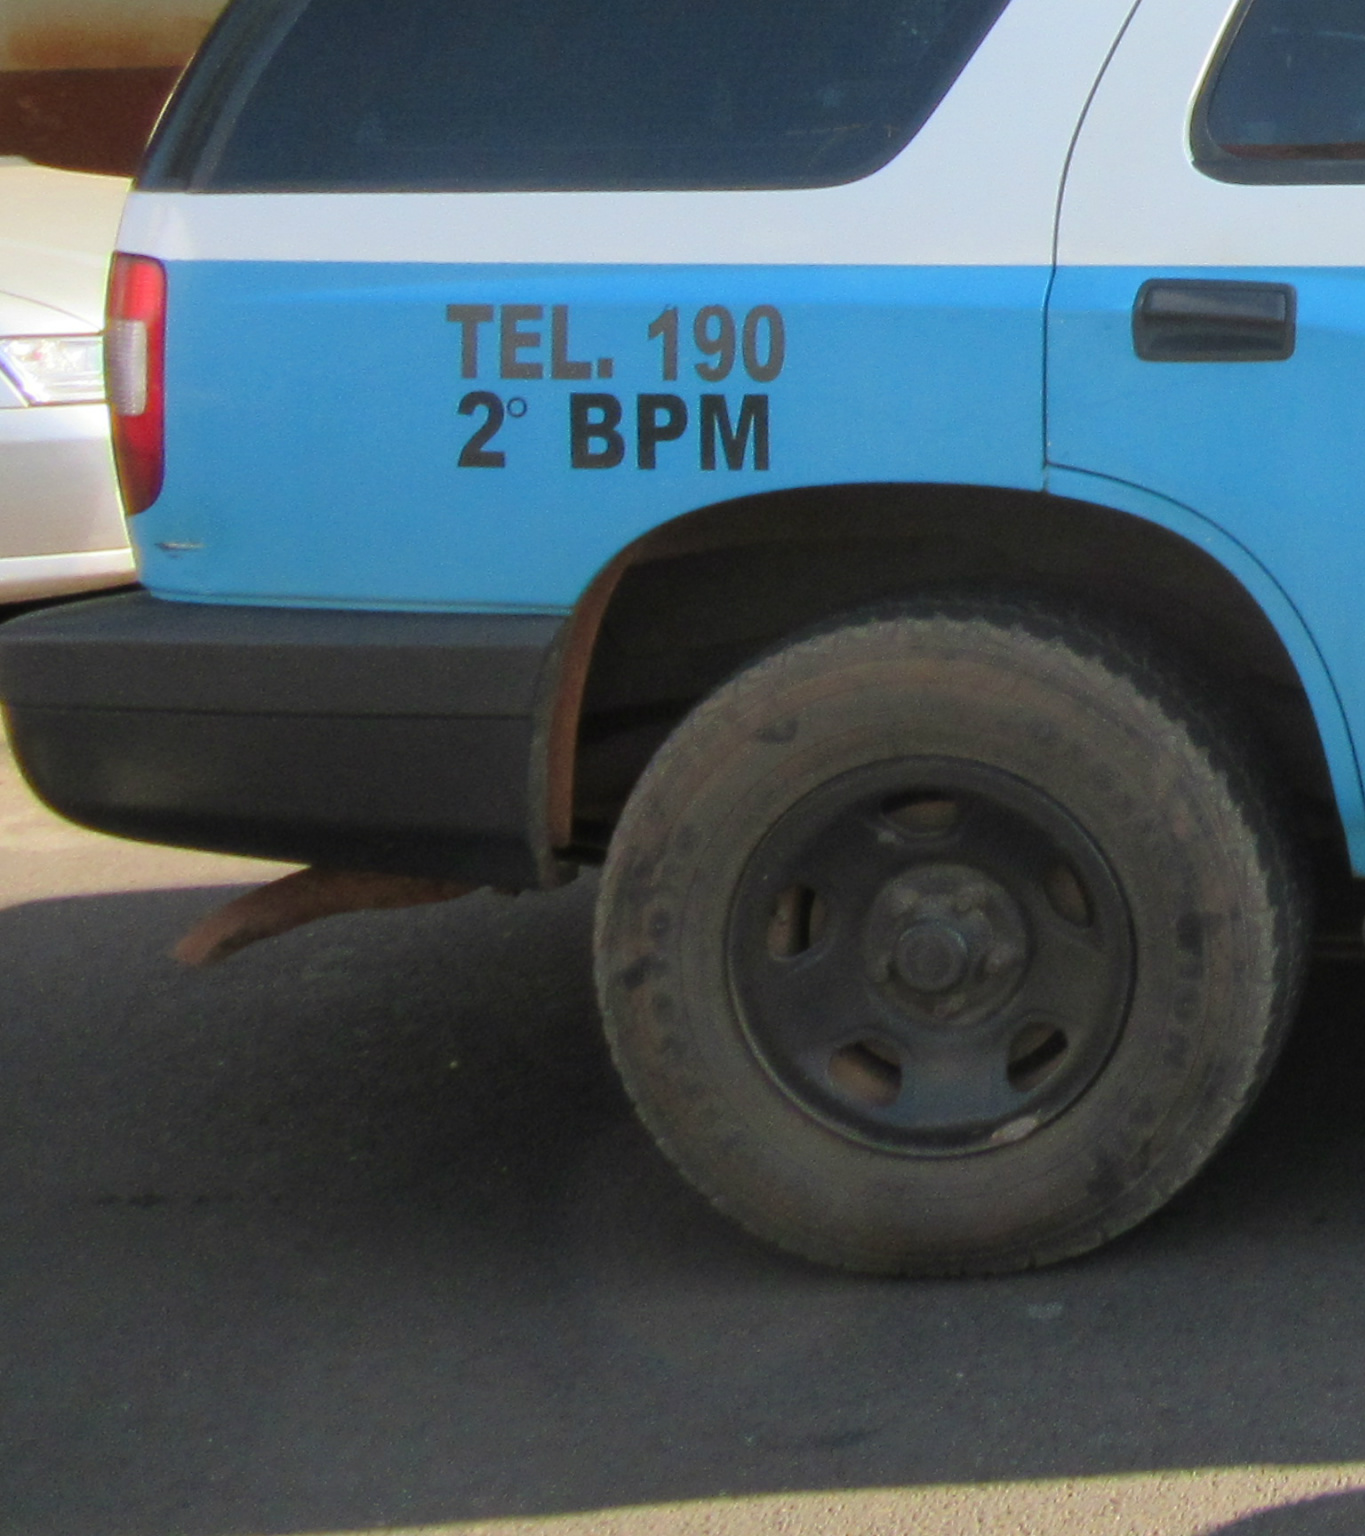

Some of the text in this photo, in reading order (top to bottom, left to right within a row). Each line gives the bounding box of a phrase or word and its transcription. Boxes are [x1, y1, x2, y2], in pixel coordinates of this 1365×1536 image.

[446, 304, 785, 382] TEL. 190
[570, 393, 770, 471] BPM
